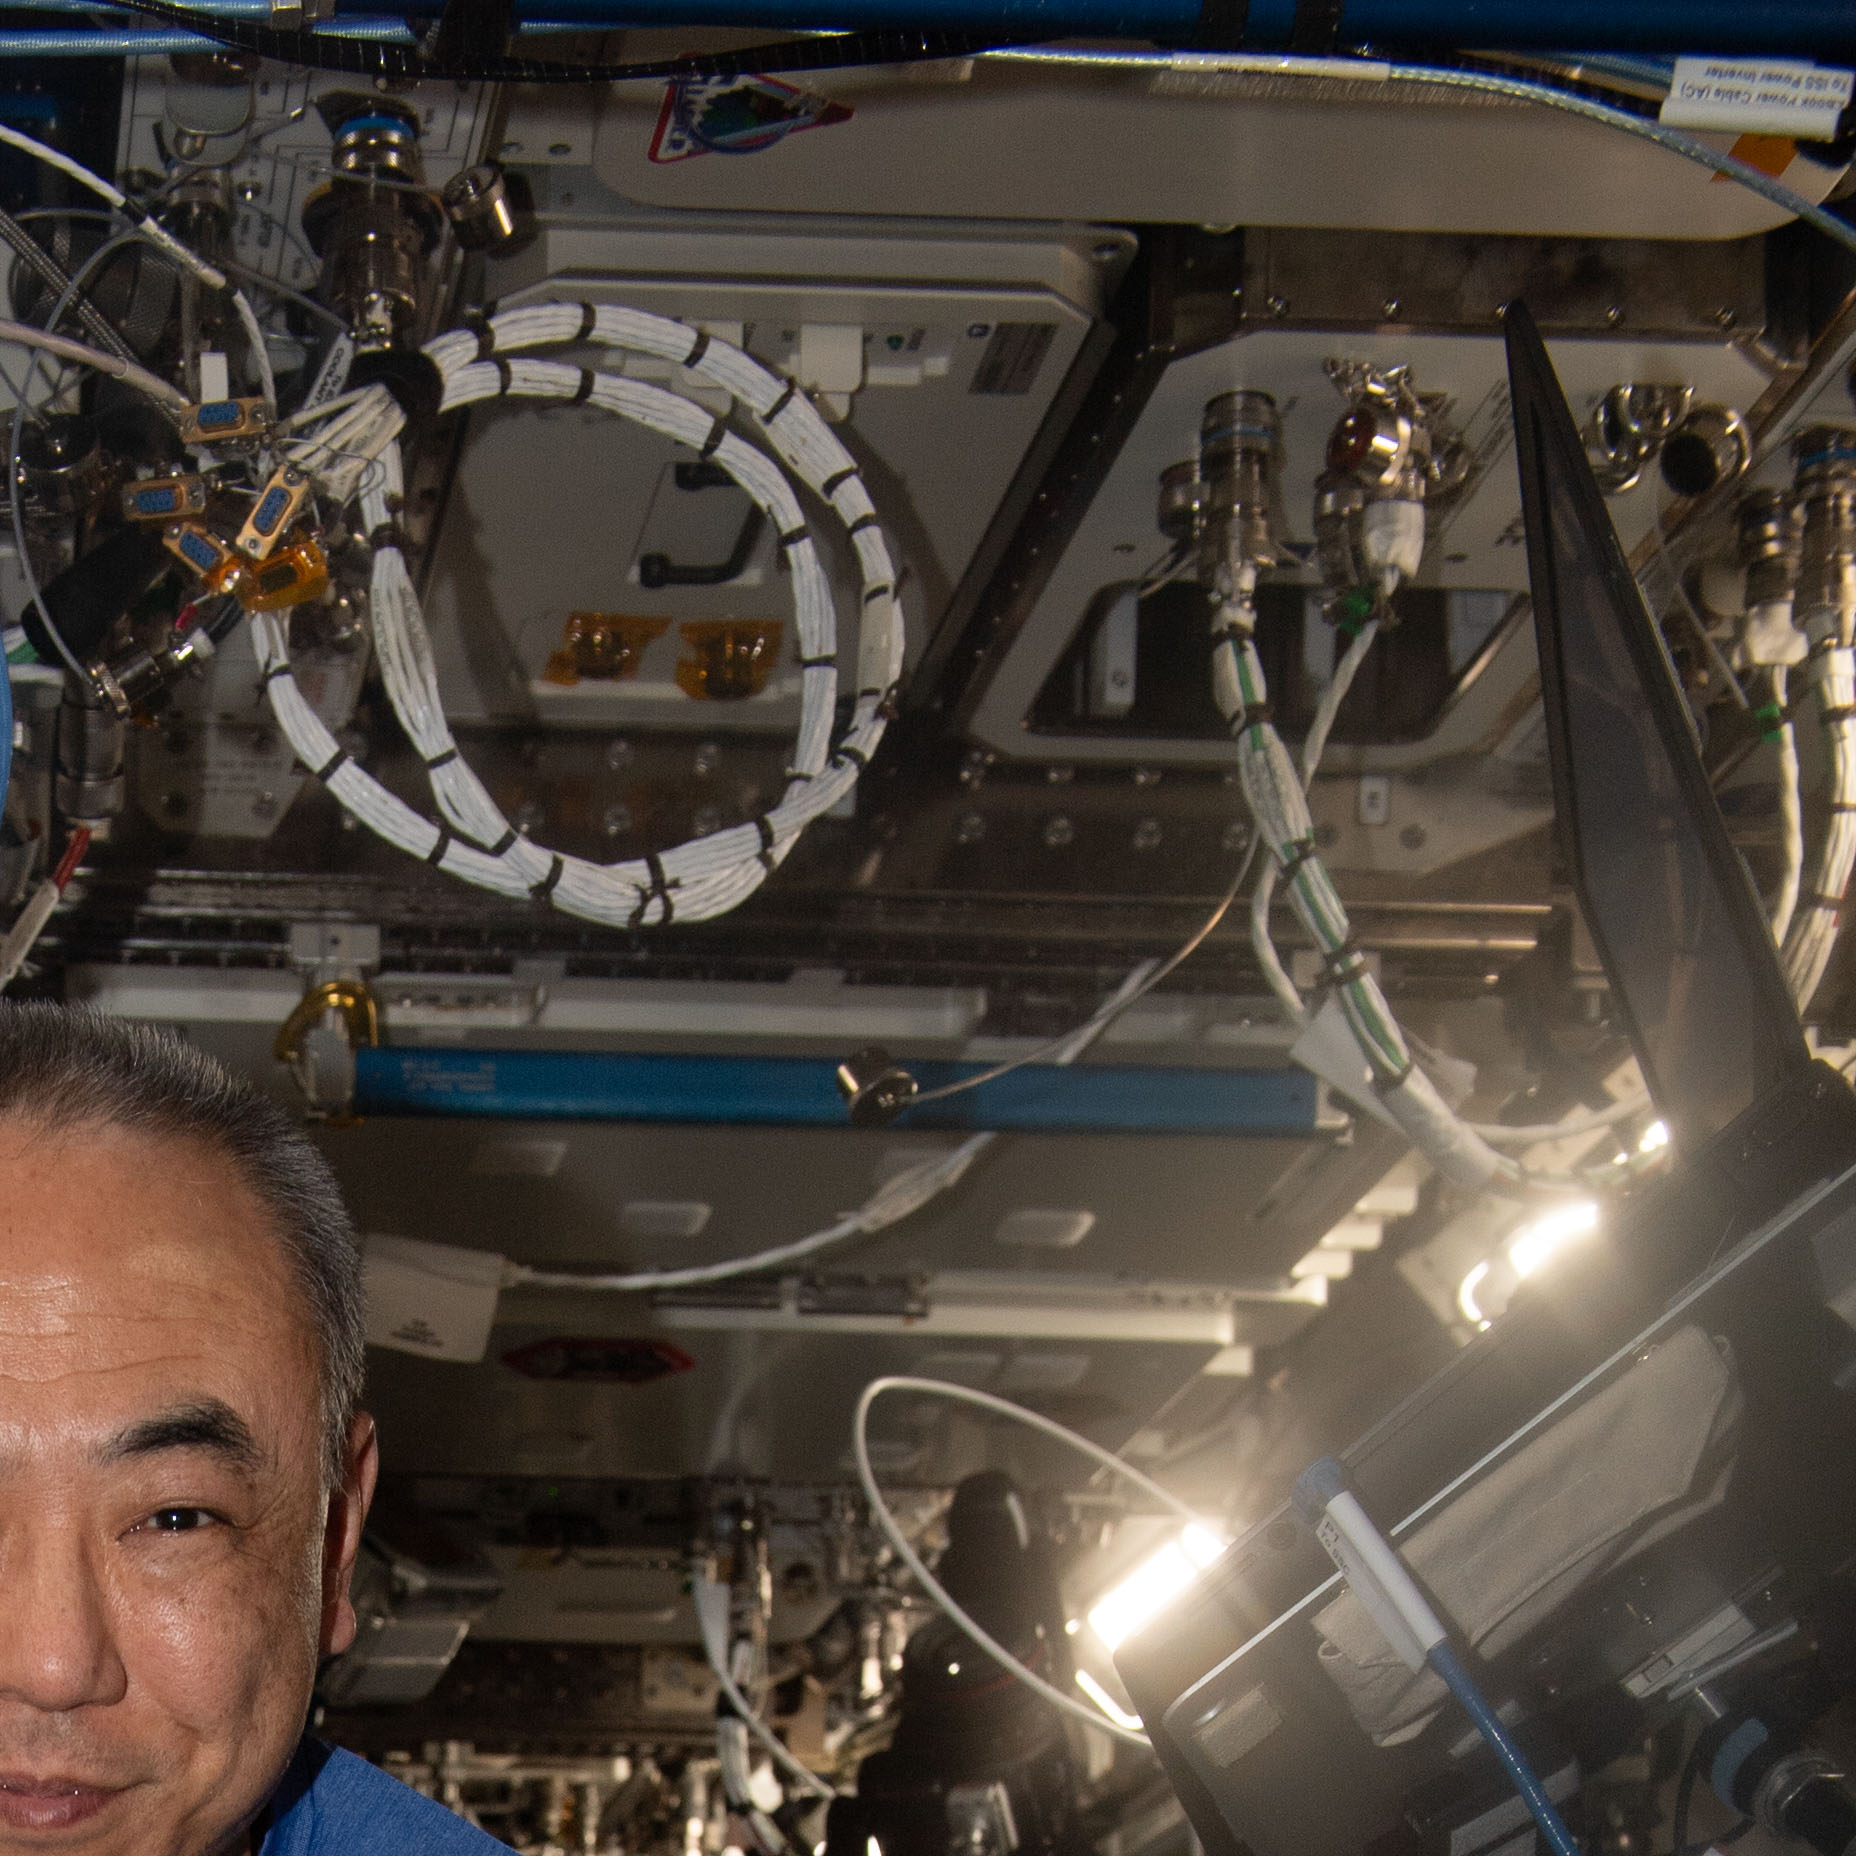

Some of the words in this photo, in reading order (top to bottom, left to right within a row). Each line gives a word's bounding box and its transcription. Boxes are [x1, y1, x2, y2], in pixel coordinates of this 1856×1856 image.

[1704, 67, 1757, 85] Inverter
[1760, 73, 1802, 88] Power
[1805, 77, 1828, 90] ISS
[1680, 83, 1711, 101] (AC)
[1832, 79, 1848, 91] To
[1714, 88, 1752, 104] Cable
